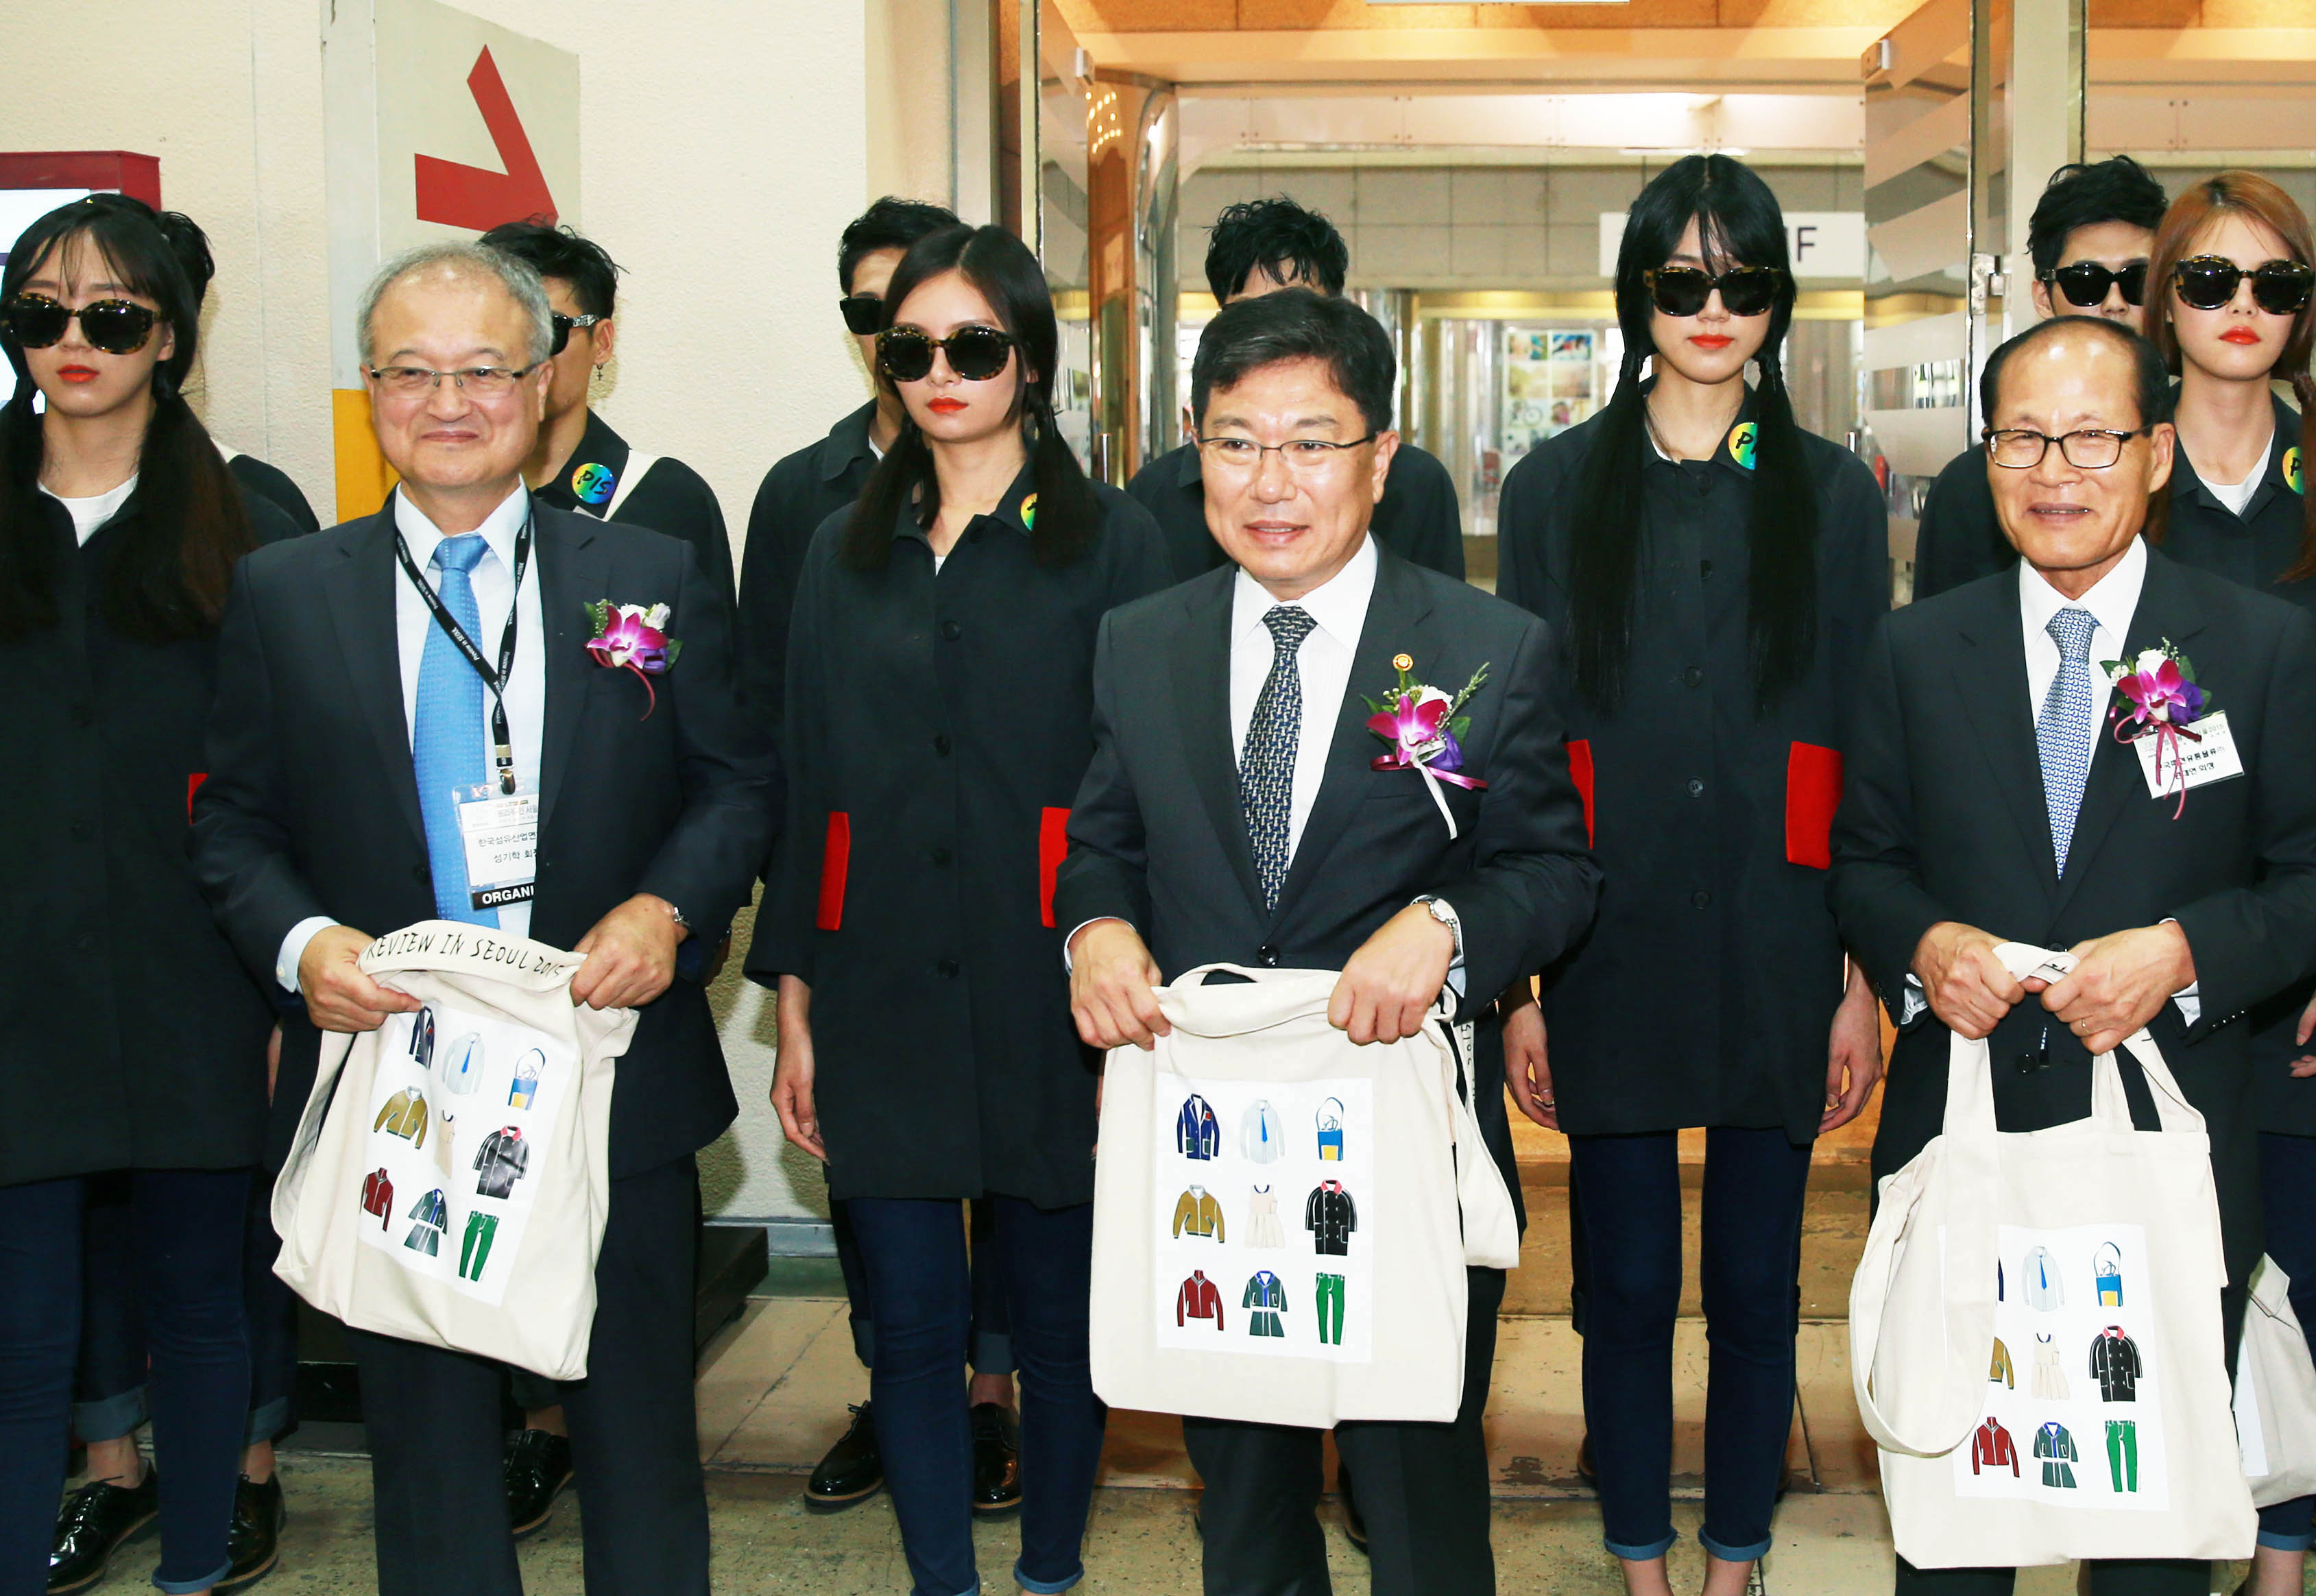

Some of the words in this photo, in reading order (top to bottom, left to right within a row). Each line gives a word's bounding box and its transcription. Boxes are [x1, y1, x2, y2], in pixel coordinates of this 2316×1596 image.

[1784, 226, 1818, 262] F
[577, 470, 612, 495] PIS
[451, 627, 465, 642] SEOUL
[478, 831, 538, 847] 한국섬유산업연
[493, 851, 520, 864] 성기학
[481, 885, 535, 904] ORGANI
[361, 932, 436, 961] REVIEW
[439, 932, 466, 956] IN
[470, 939, 528, 969] SEOUL
[533, 956, 566, 978] 2015
